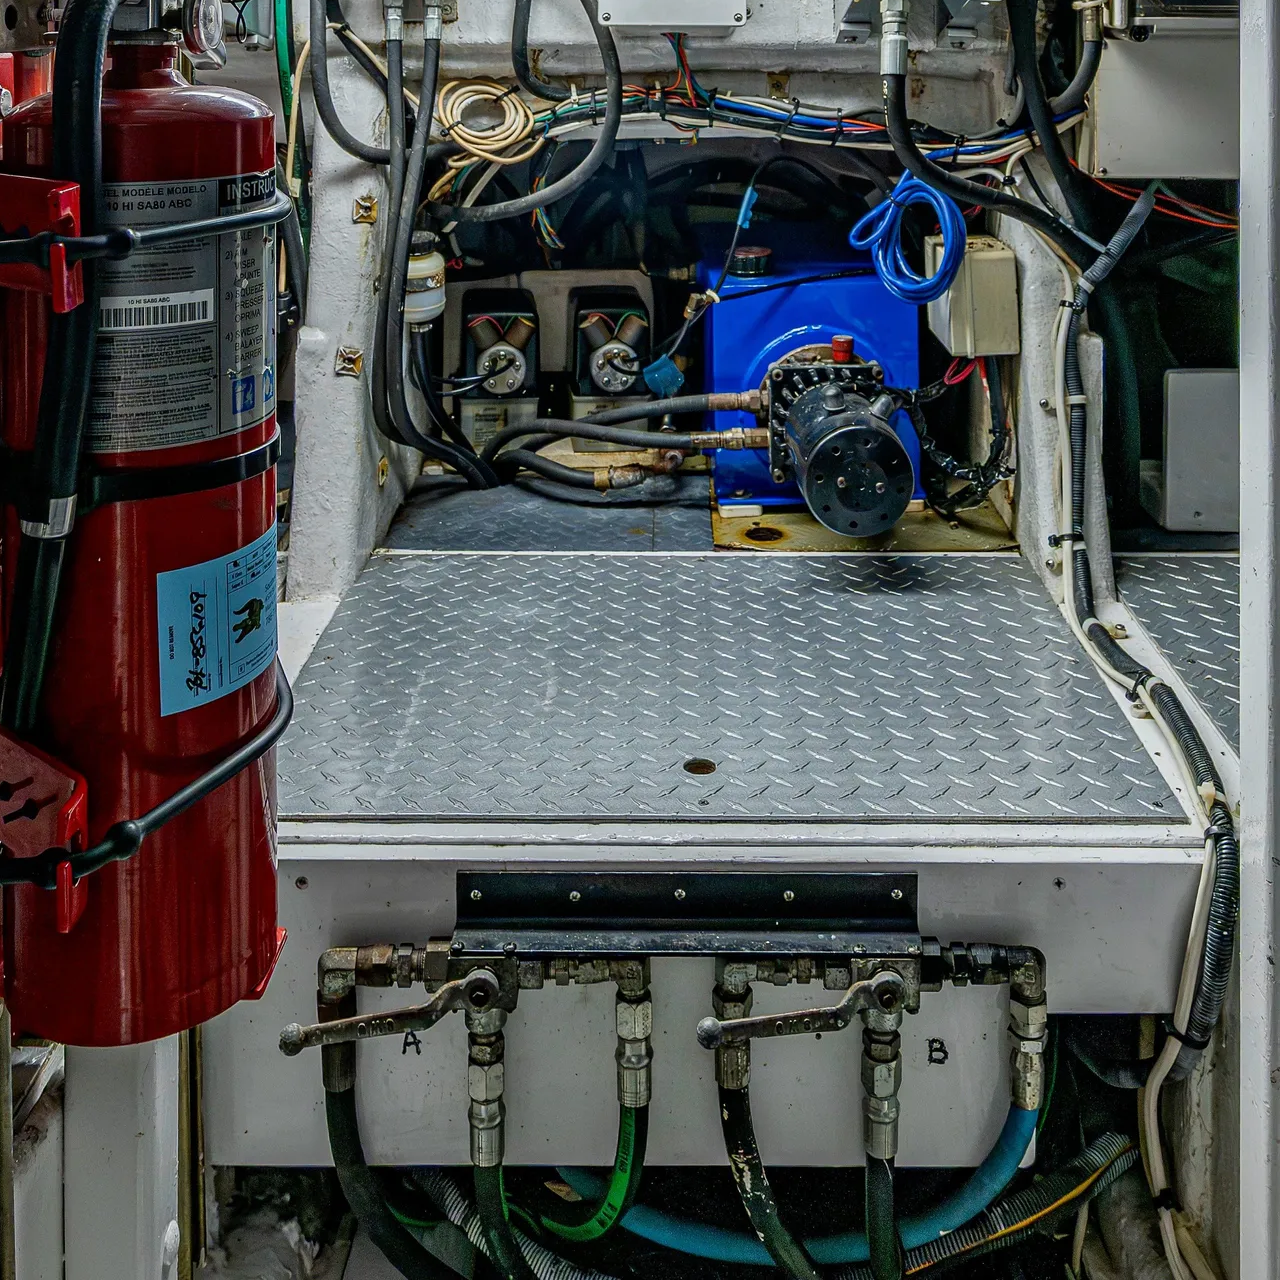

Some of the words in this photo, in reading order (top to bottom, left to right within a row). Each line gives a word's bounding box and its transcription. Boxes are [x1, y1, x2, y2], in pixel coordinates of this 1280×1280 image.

[122, 186, 164, 197] MODÈLE
[166, 184, 207, 196] MODELO
[122, 201, 134, 211] HI
[137, 200, 166, 210] SA80
[168, 198, 193, 209] ABC
[225, 250, 233, 260] 2)
[402, 1030, 422, 1055] A
[926, 1037, 949, 1066] B
